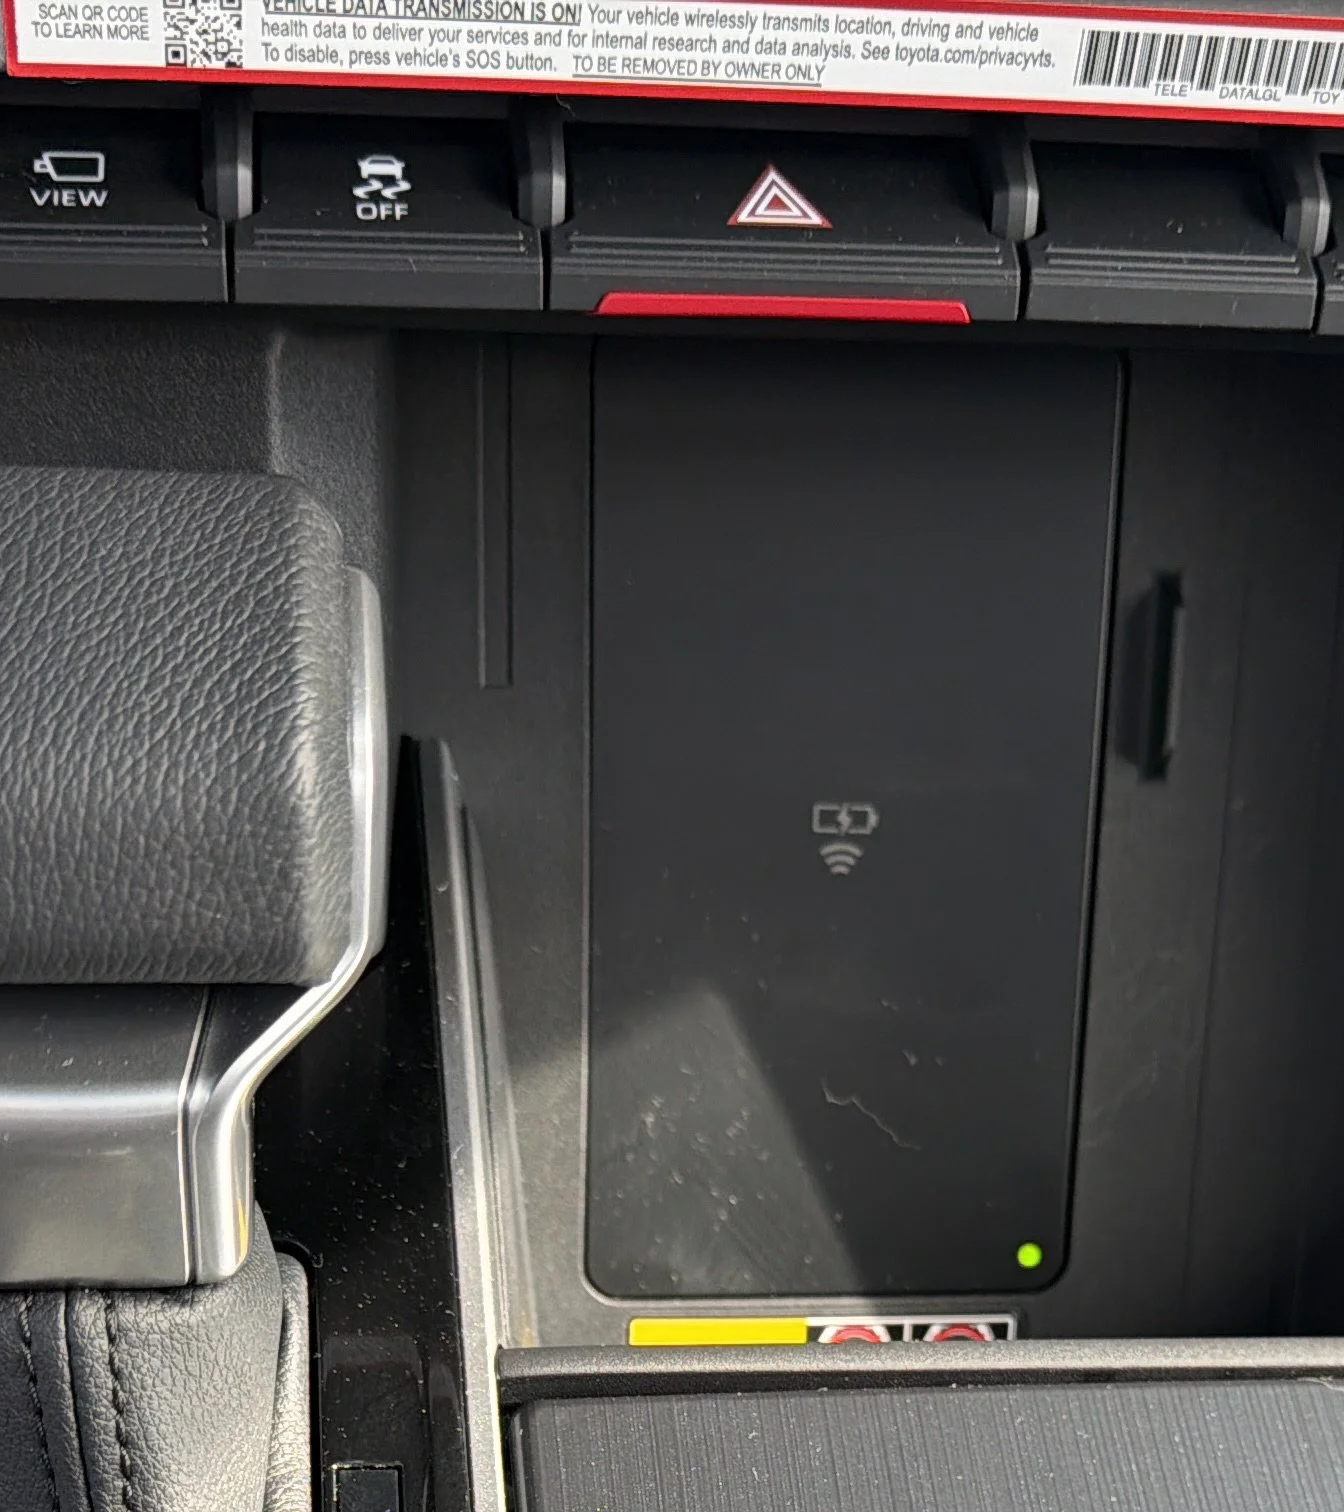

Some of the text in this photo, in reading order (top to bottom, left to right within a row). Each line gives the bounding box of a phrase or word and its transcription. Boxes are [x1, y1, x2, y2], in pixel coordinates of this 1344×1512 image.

[38, 3, 149, 23] SCAN QR CODE
[342, 0, 387, 16] DATA
[396, 0, 525, 20] TRANSMISSION
[530, 2, 546, 21] IS
[552, 2, 581, 22] ON!
[588, 5, 622, 25] Your
[627, 7, 679, 27] vehicle
[685, 9, 758, 34] wirelessly
[762, 11, 829, 34] transmits
[834, 14, 896, 38] location,
[901, 17, 950, 42] driving
[955, 20, 984, 40] and
[988, 21, 1039, 42] vehicle
[31, 21, 150, 41] TO LEARN MORE
[261, 18, 308, 38] health
[313, 20, 346, 39] data
[353, 22, 367, 40] to
[372, 22, 424, 42] deliver
[428, 27, 462, 47] your
[467, 27, 528, 46] services
[534, 29, 561, 48] and
[567, 30, 588, 48] for
[592, 31, 647, 51] internal
[652, 33, 716, 53] research
[722, 36, 749, 55] and
[755, 37, 787, 56] data
[792, 40, 855, 61] analysis.
[861, 41, 890, 61] See
[261, 42, 826, 82] To disable, press vehicle's SOS button. TO BE REMOVED BY OWNER ONLY
[1153, 83, 1189, 97] TELE
[1312, 91, 1341, 105] TOY
[30, 187, 109, 209] VIEW
[355, 201, 409, 221] OFF
